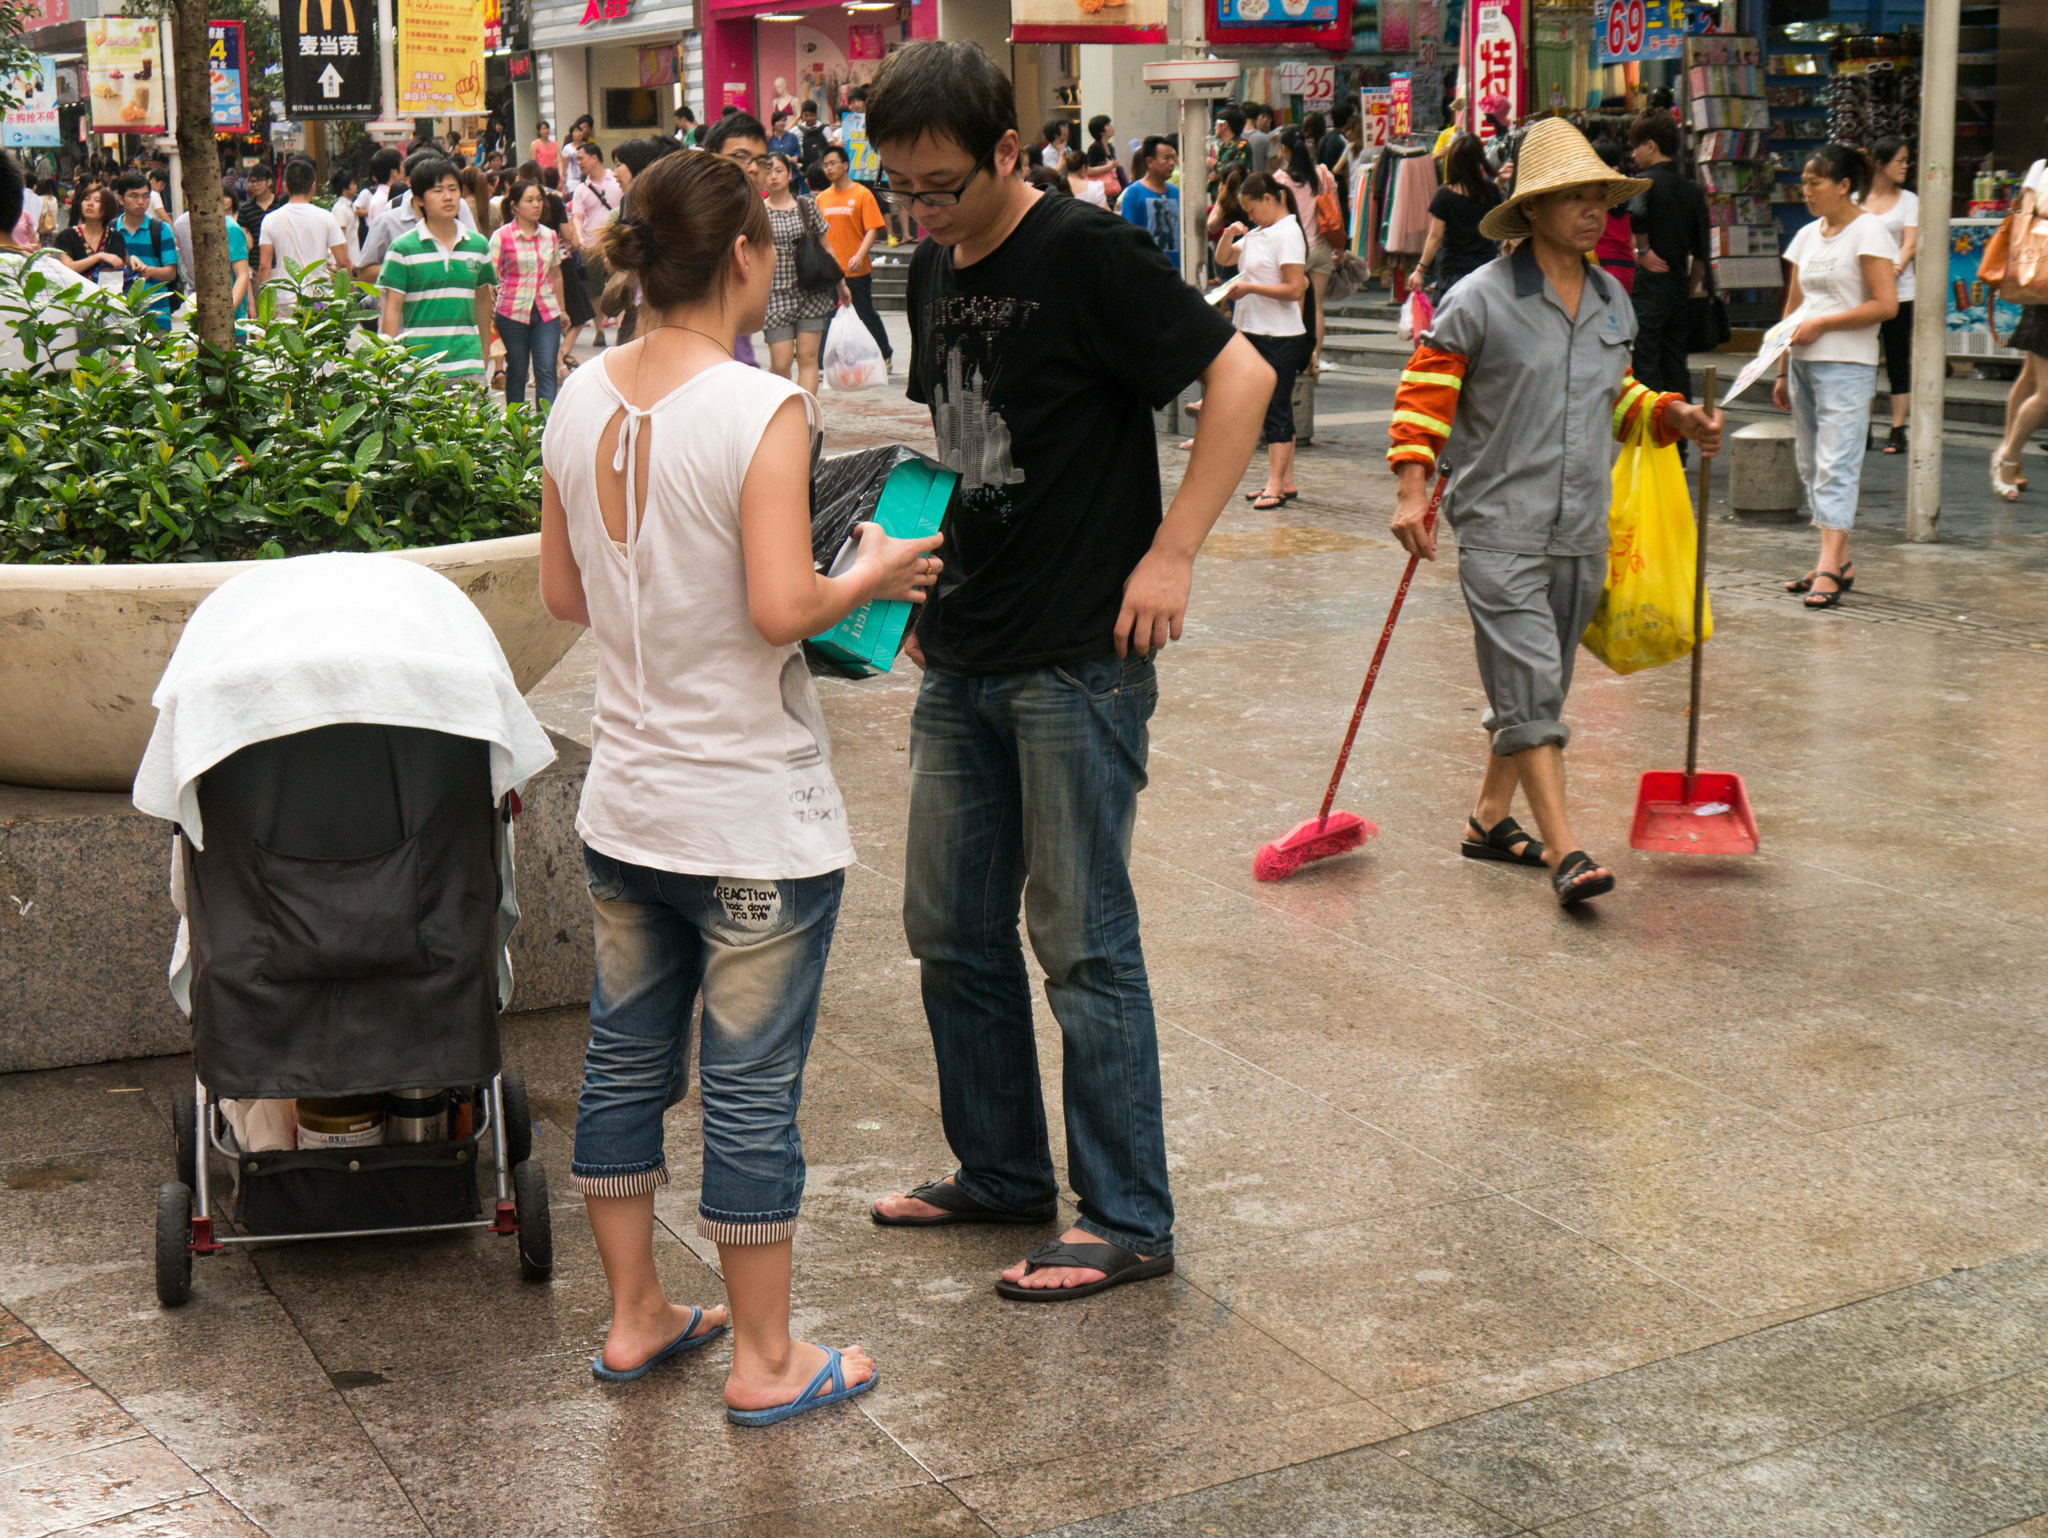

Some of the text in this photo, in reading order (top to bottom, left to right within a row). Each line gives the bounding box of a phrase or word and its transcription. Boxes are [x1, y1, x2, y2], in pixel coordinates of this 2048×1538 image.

[1608, 0, 1645, 56] 69
[299, 35, 359, 56] 麦当劳
[1305, 67, 1334, 98] 35
[1395, 102, 1408, 133] 25
[850, 142, 877, 169] 7.8
[716, 886, 778, 901] REACTtaw
